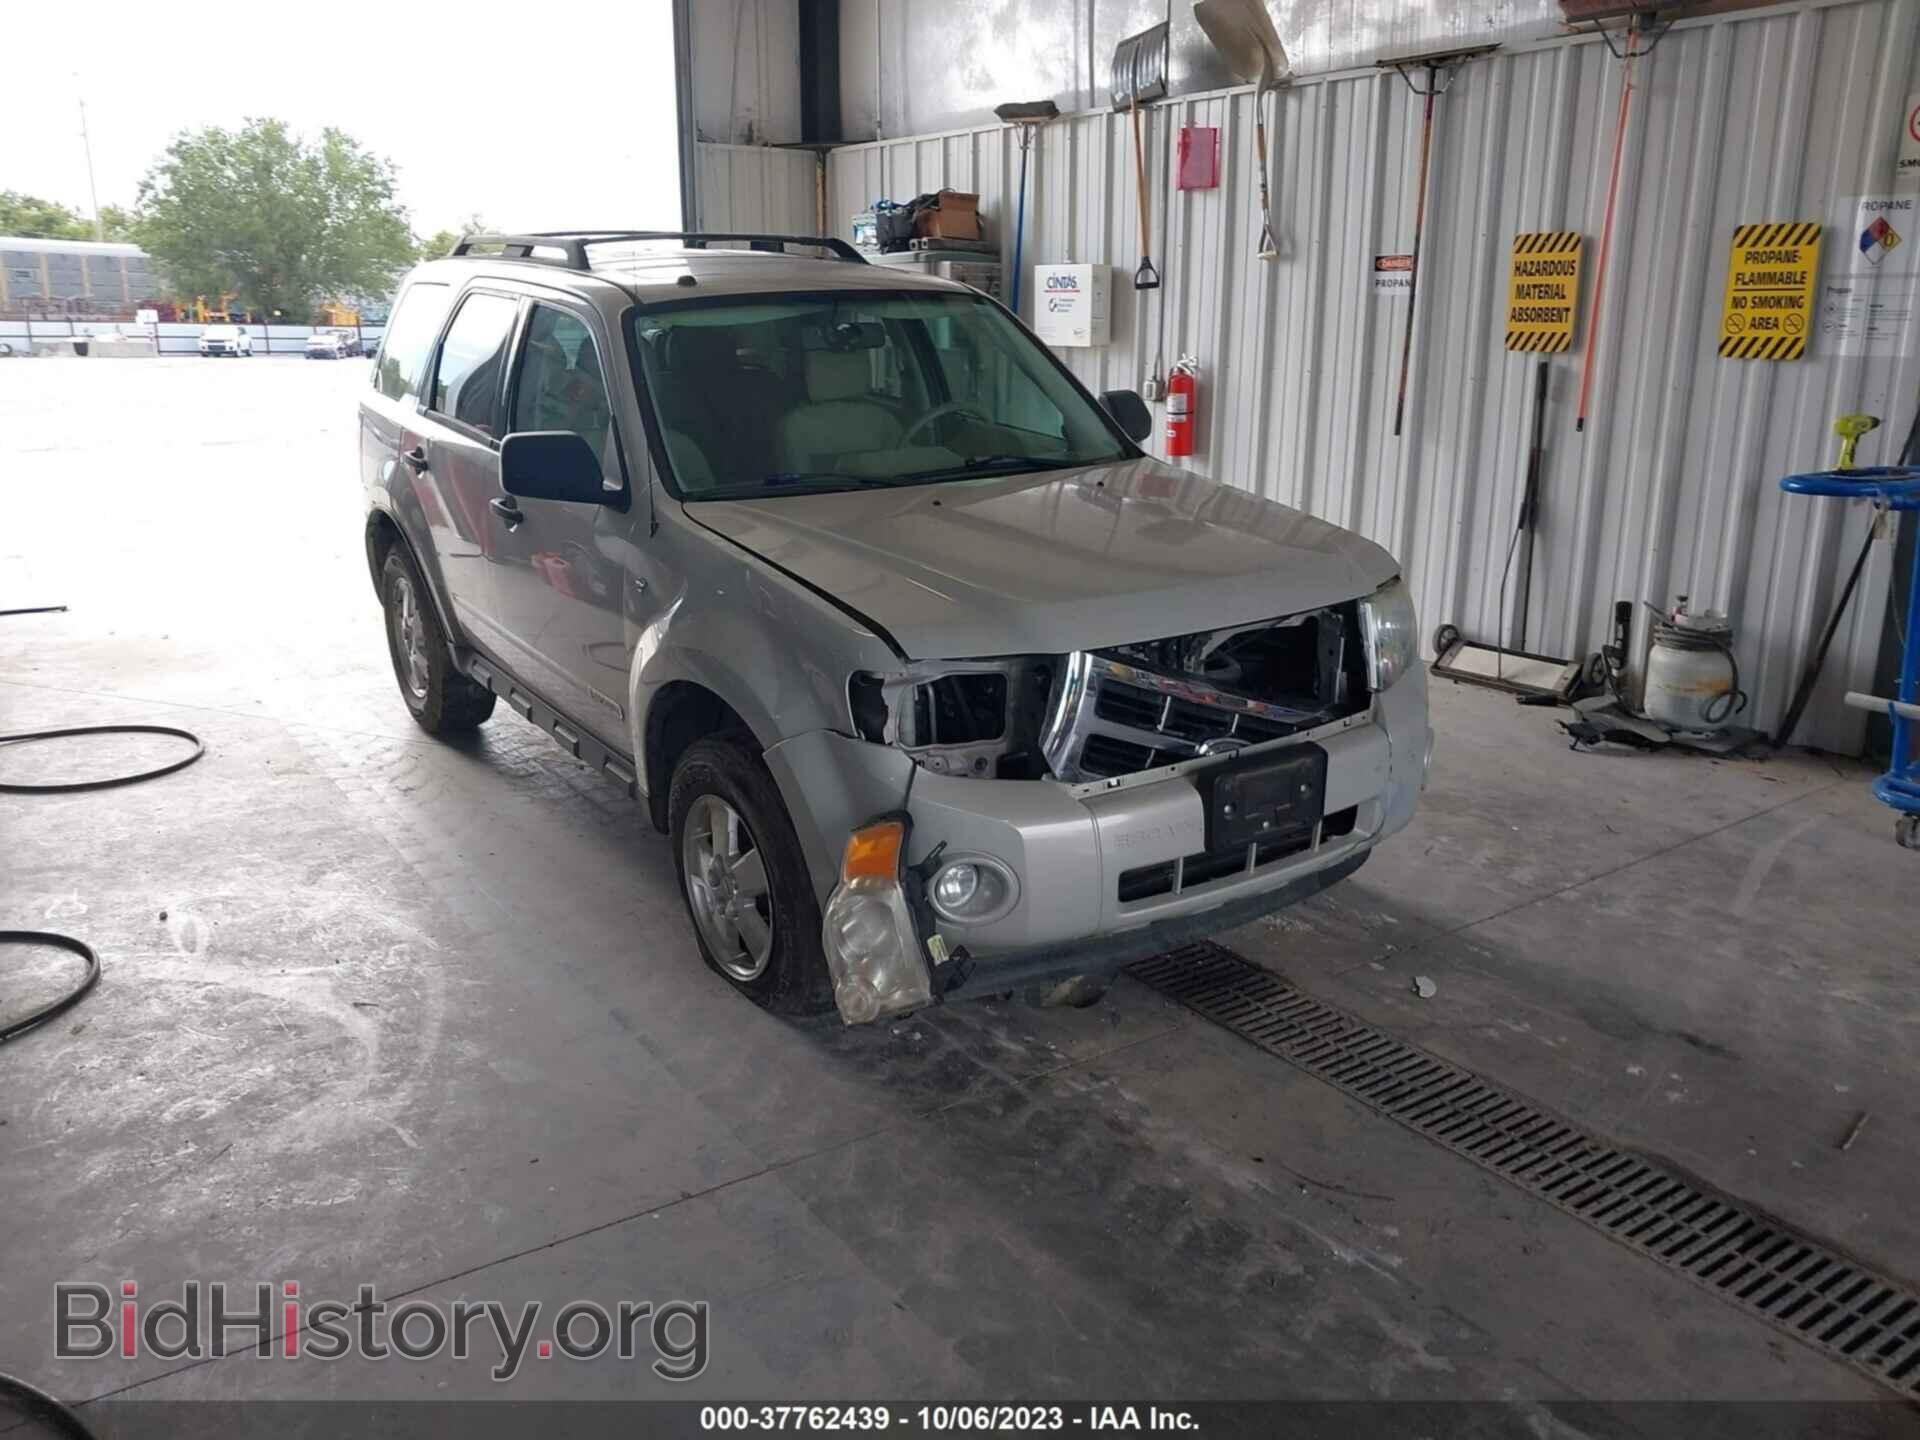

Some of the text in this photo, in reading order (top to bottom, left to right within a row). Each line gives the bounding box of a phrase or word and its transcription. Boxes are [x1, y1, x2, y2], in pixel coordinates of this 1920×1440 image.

[1858, 200, 1912, 211] ROPANE
[1514, 259, 1577, 277] HAZARDOUS
[1376, 279, 1412, 288] PROPAN
[1734, 271, 1808, 286] FLAMMABLE
[1515, 283, 1567, 300] MATERIAL
[1731, 295, 1804, 310] NO SMOKING
[1510, 306, 1571, 323] ABSORBENT
[1748, 316, 1780, 330] AREA
